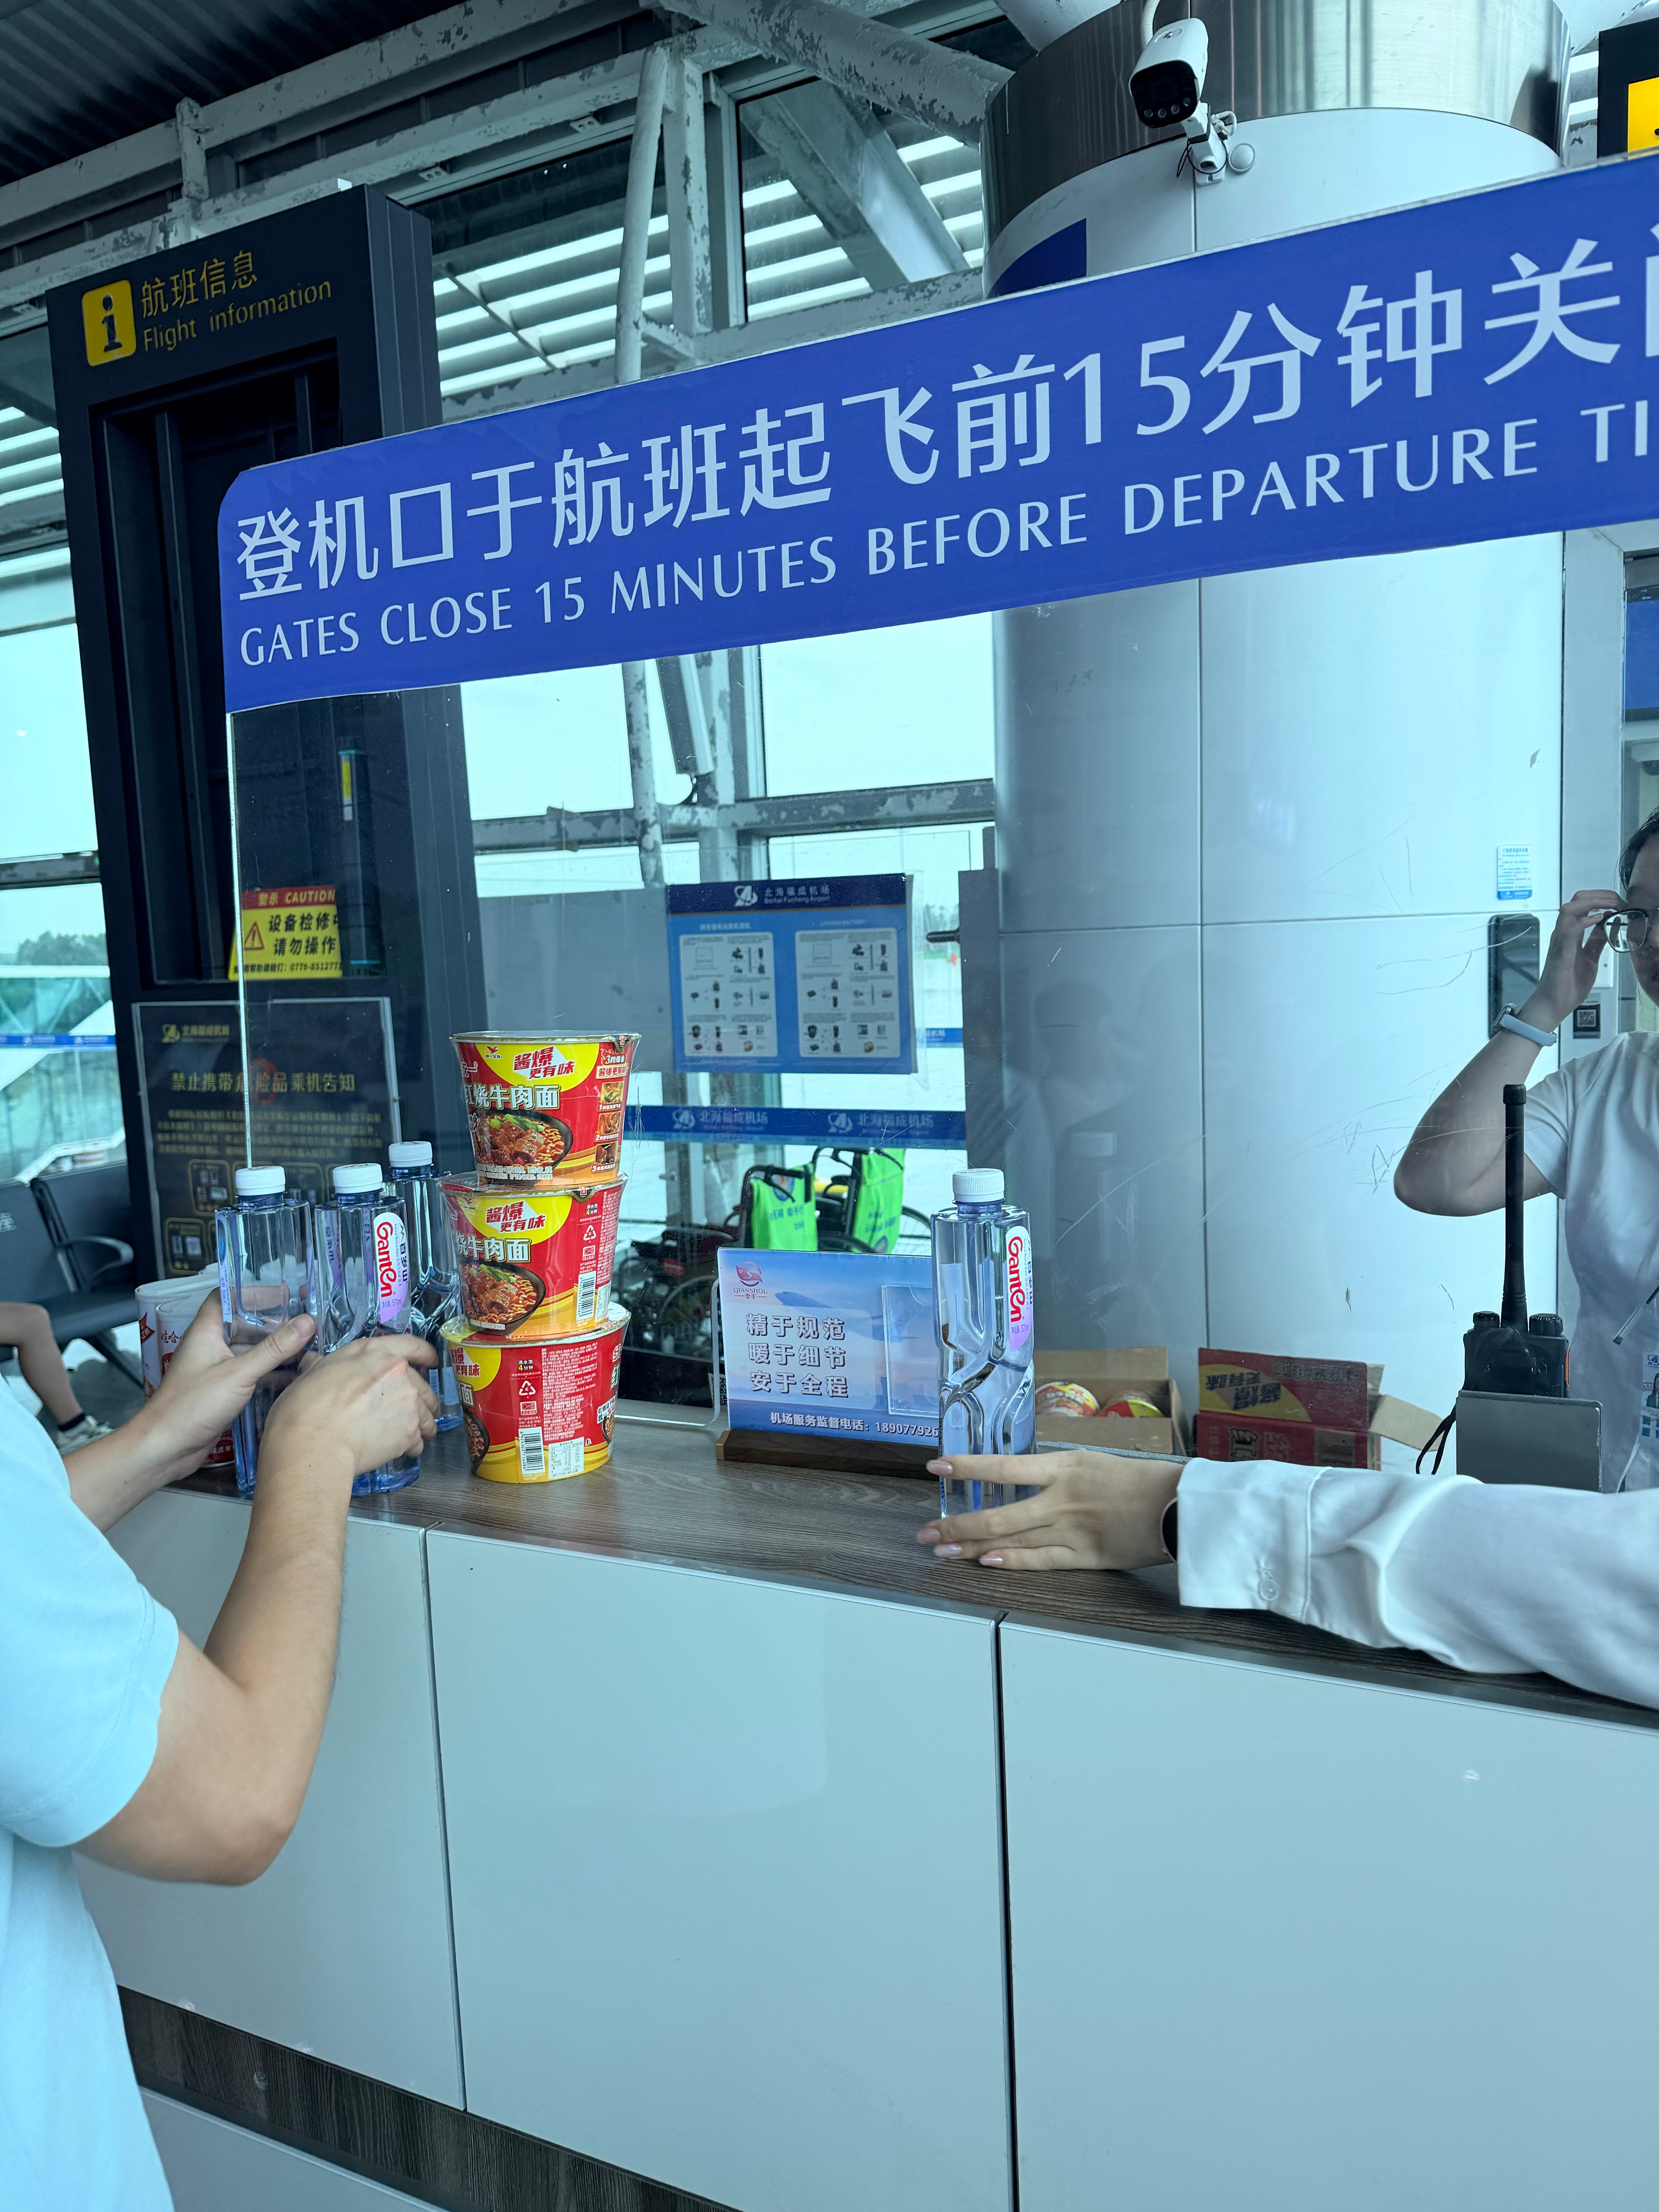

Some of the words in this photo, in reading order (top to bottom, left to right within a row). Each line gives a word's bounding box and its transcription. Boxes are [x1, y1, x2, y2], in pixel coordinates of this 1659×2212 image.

[140, 250, 257, 318] 航班信息
[143, 318, 196, 352] Flight
[209, 278, 331, 332] information
[236, 225, 1659, 601] 登机口于航班起飞前15分钟关
[240, 612, 359, 666] GATES
[381, 587, 512, 646] CLOSE
[534, 577, 584, 623] 15
[611, 536, 836, 615] MINUTES
[868, 493, 1087, 575] BEFORE
[1125, 419, 1538, 535] DEPARTURE
[258, 892, 279, 907] 警示
[285, 889, 336, 904] CAUTION
[274, 935, 337, 956] 请勿操作
[514, 1046, 554, 1071] 酱爆
[528, 1060, 575, 1080] 更有味
[486, 1200, 524, 1223] 酱爆
[500, 1214, 546, 1233] 更有味
[746, 1313, 845, 1340] 精于规范
[748, 1342, 846, 1369] 暖于细节
[750, 1370, 848, 1398] 安于全程
